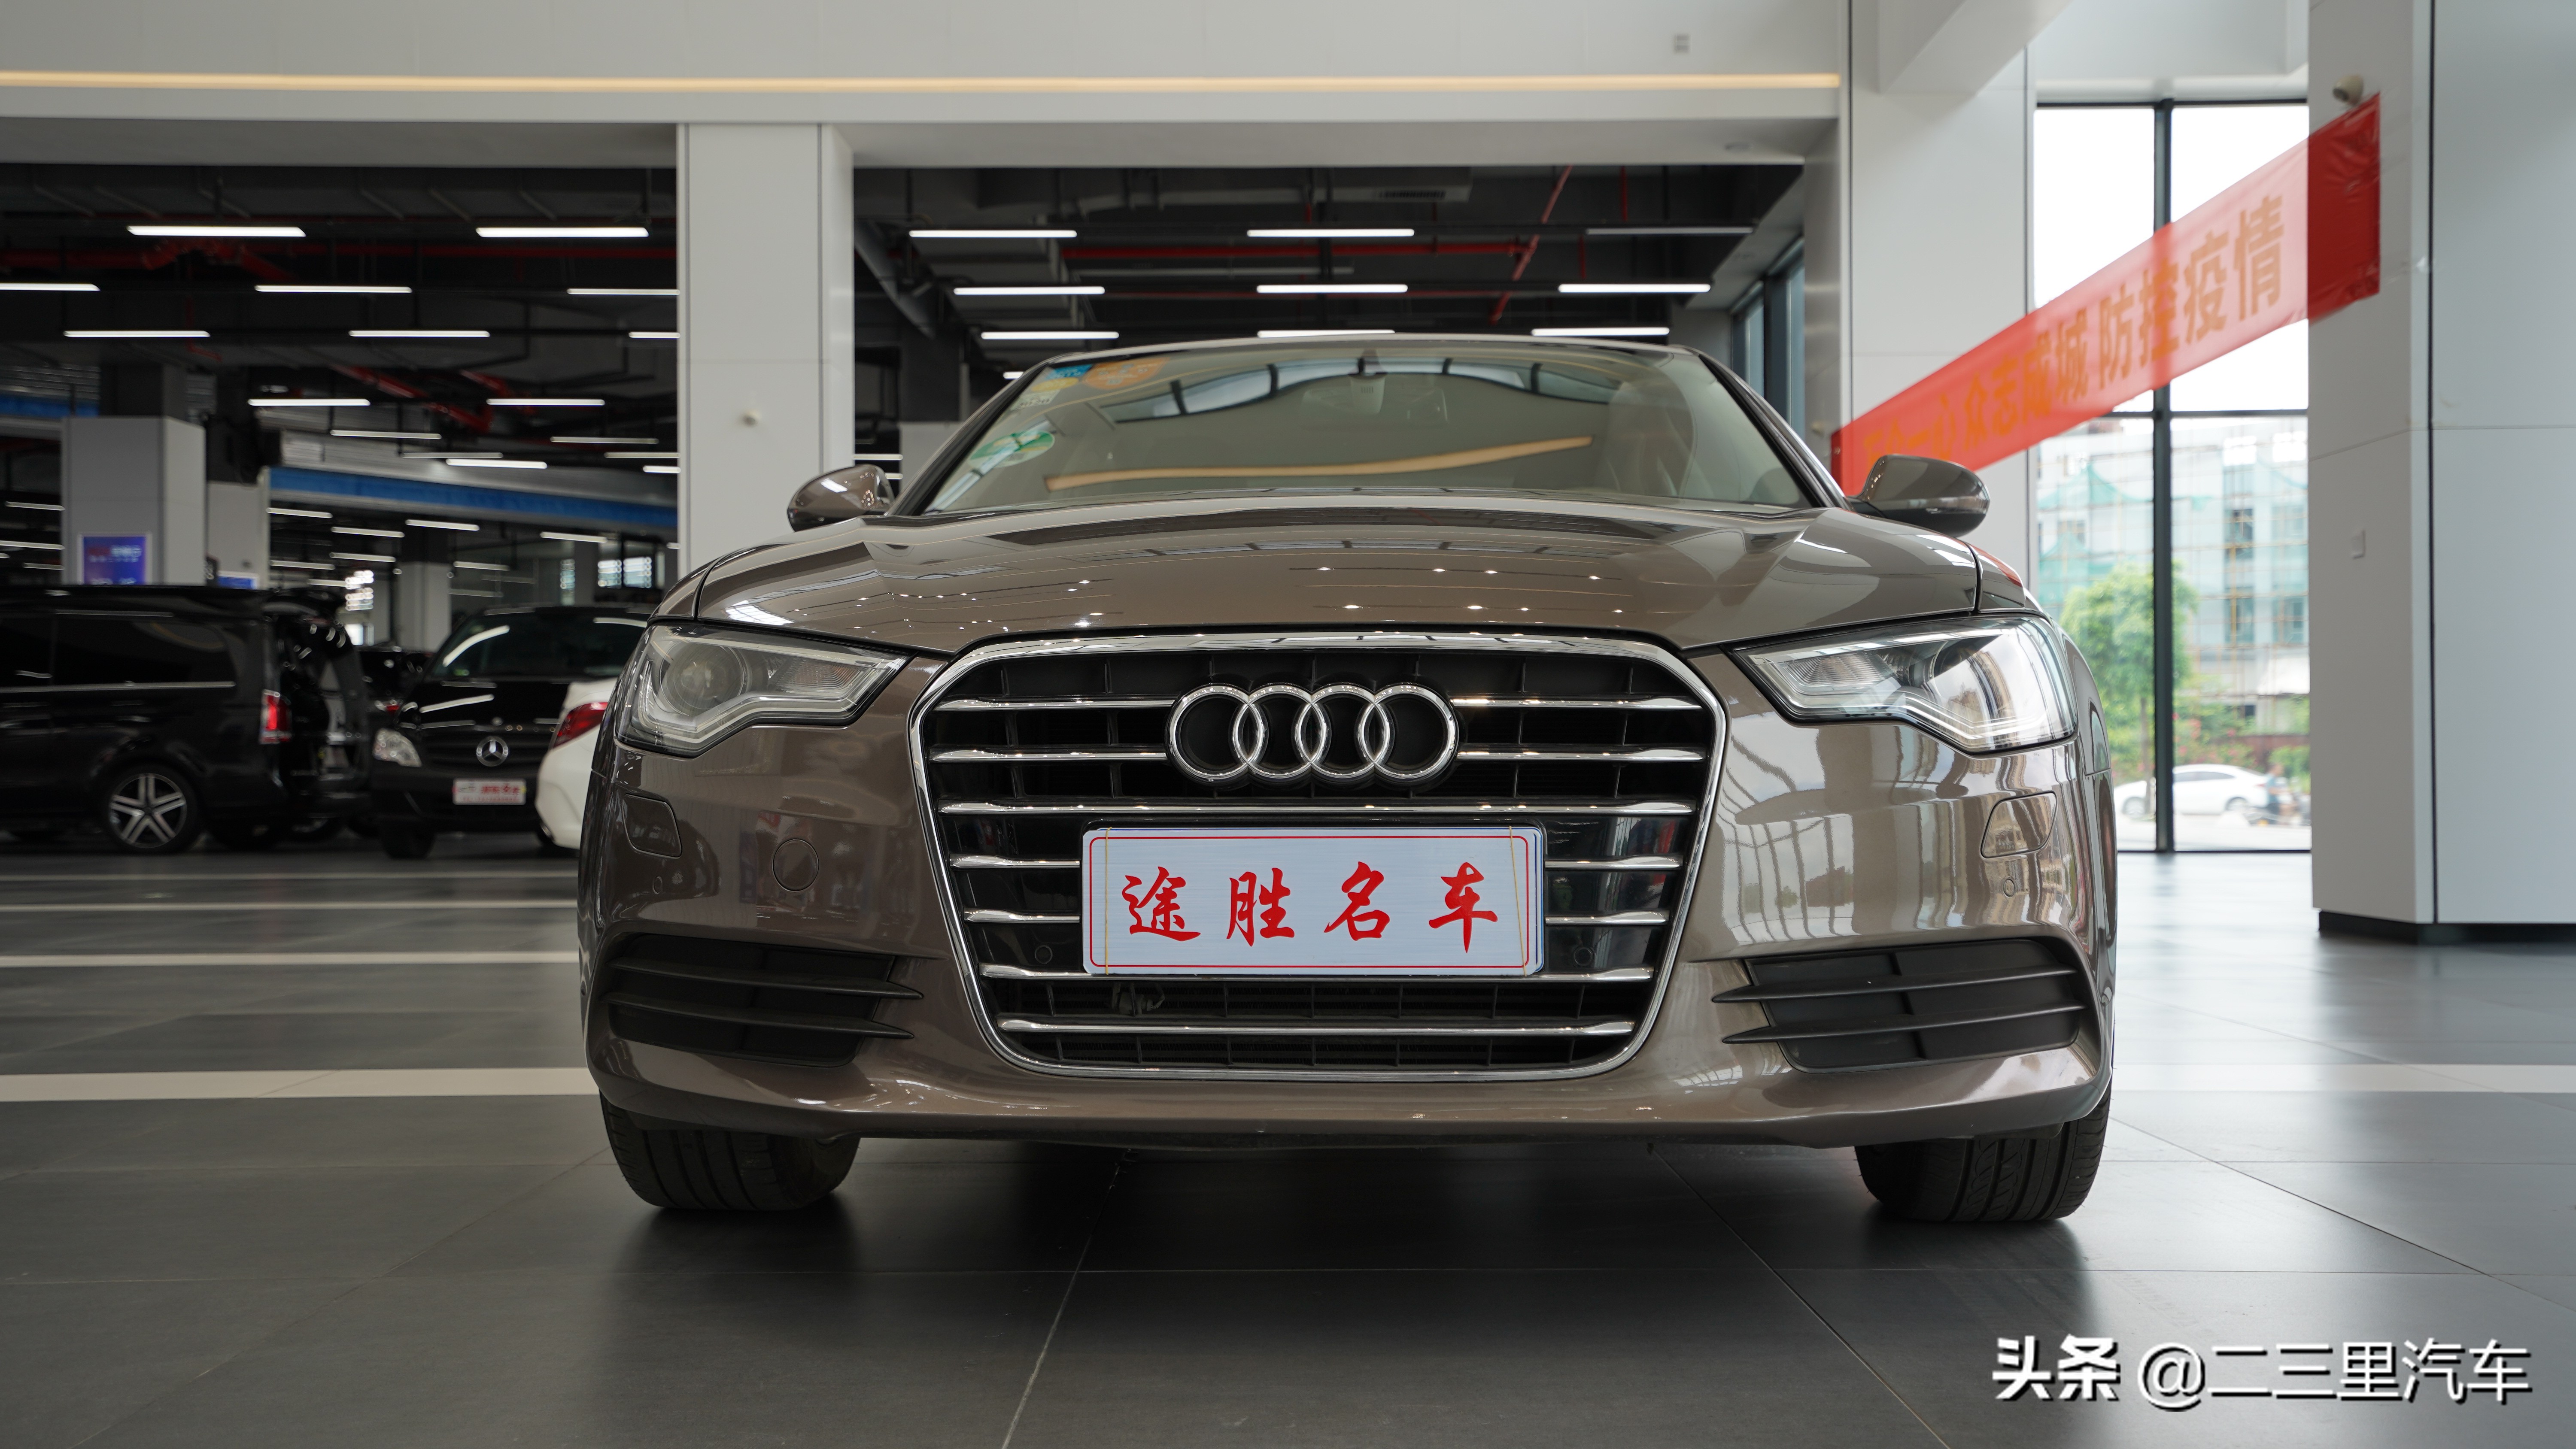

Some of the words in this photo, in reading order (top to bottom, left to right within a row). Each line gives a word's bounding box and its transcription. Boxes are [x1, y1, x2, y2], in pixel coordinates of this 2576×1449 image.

[2098, 194, 2284, 390] 防控疫情
[1122, 861, 1498, 954] 途胜名车
